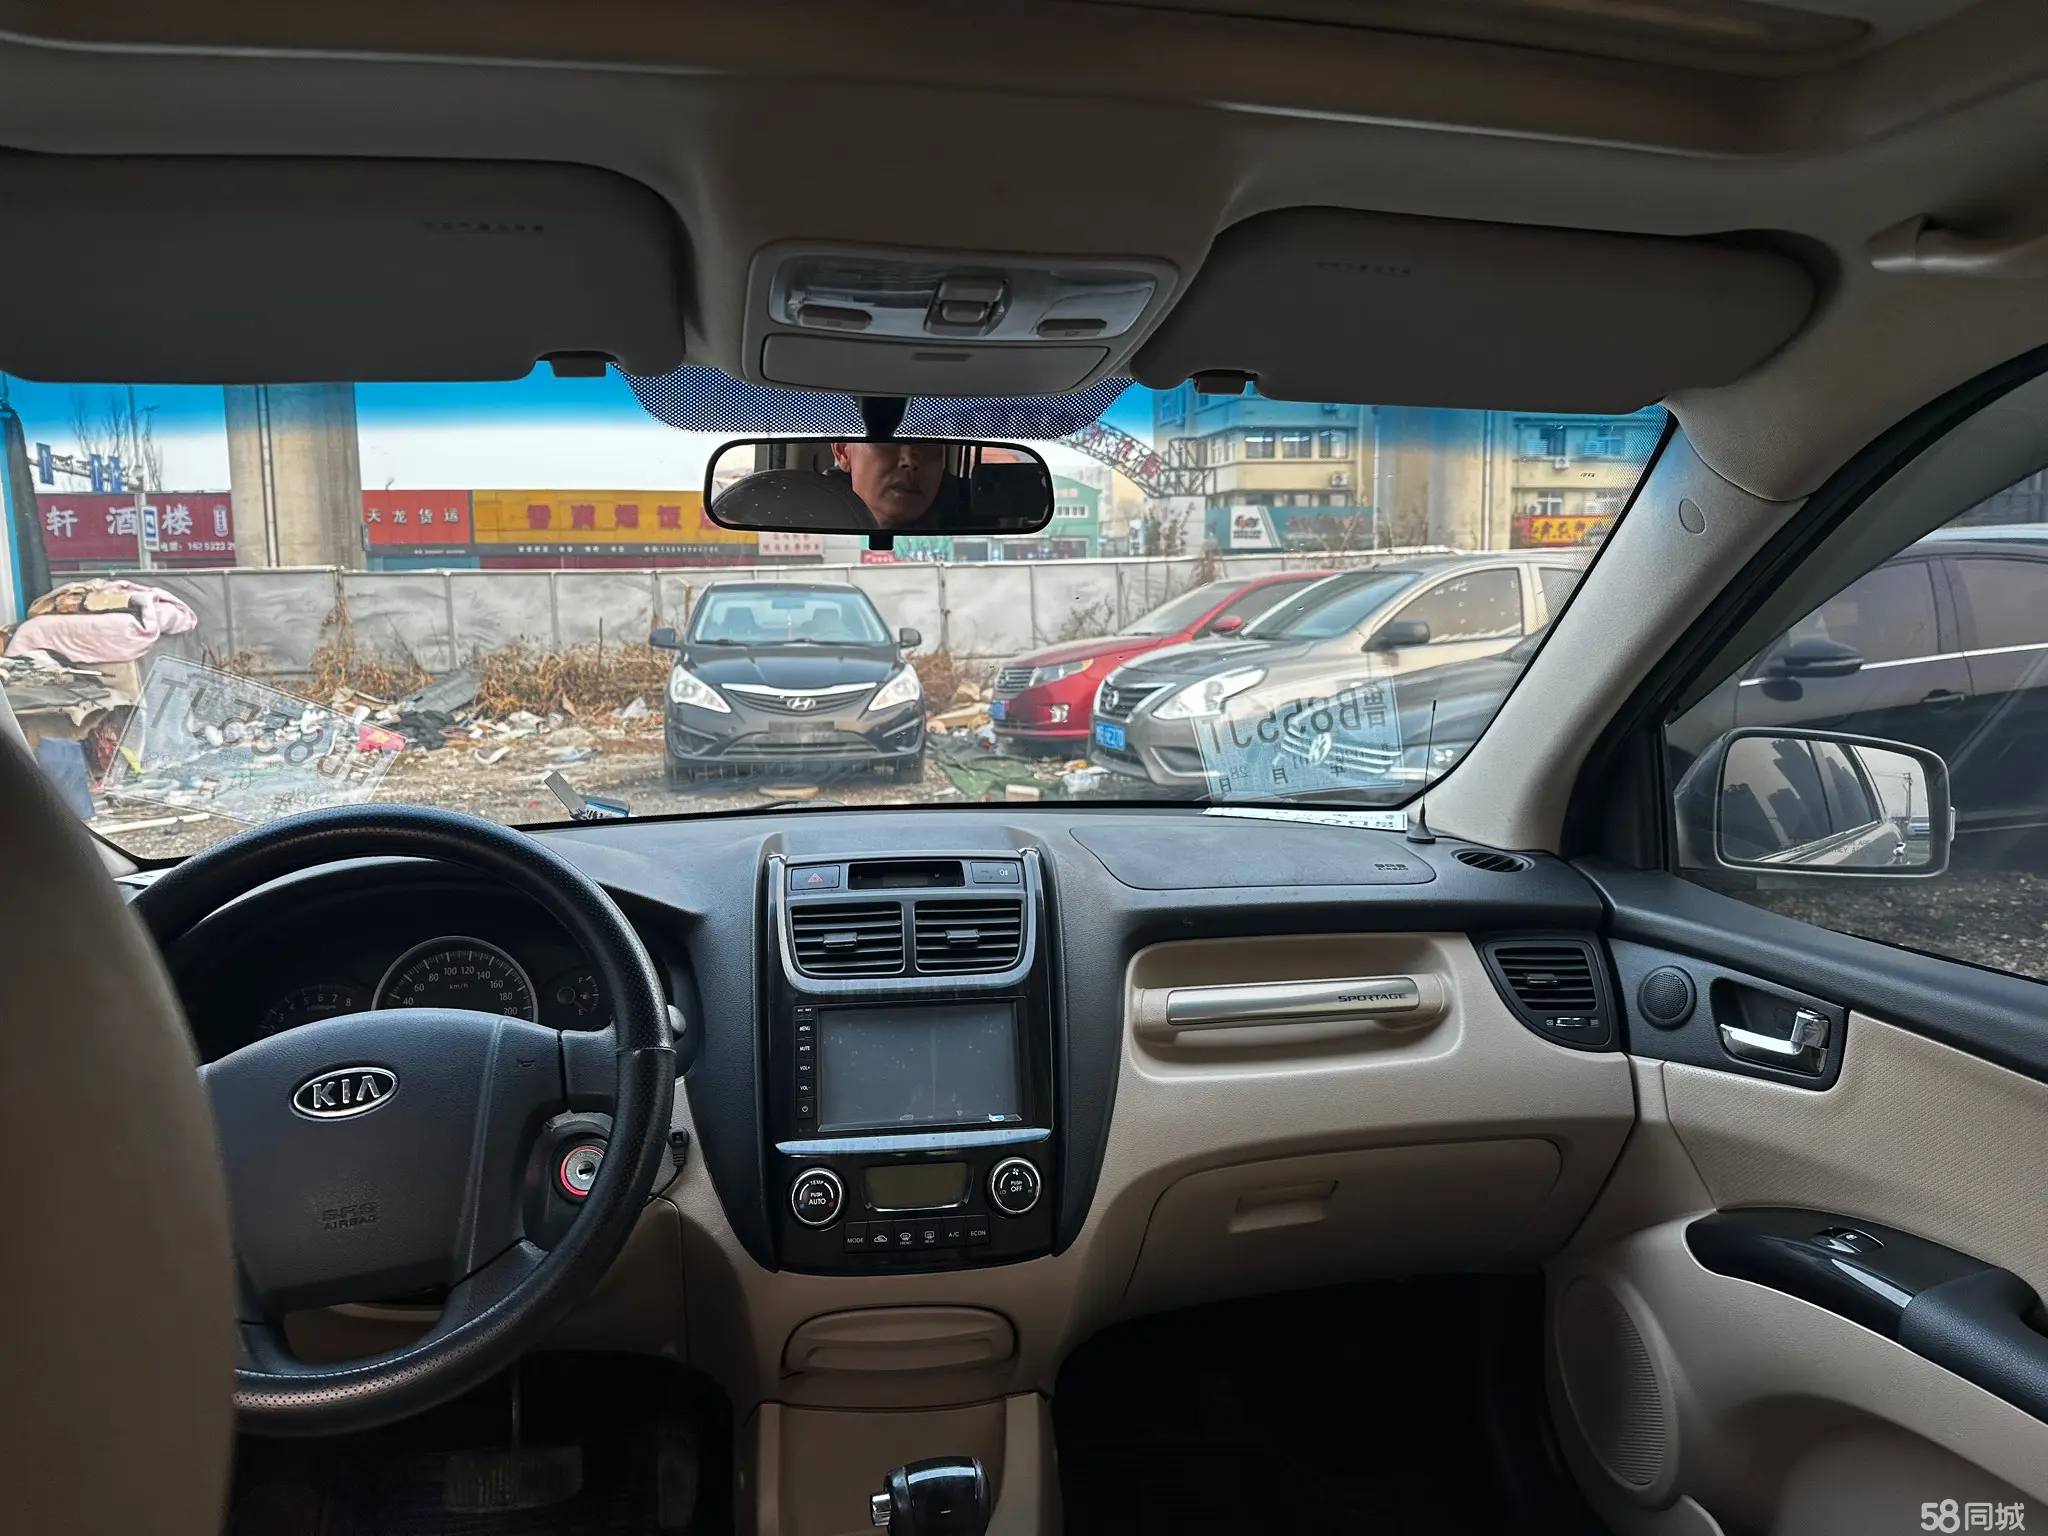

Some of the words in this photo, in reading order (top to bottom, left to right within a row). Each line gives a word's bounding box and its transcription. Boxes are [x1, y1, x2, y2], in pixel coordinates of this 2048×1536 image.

[367, 508, 461, 524] 天龙货运
[444, 967, 457, 975] 100
[461, 966, 475, 975] 120
[428, 973, 439, 982] 80
[477, 971, 491, 980] 140
[414, 983, 425, 992] 60
[490, 980, 504, 989] 160
[500, 992, 513, 1001] 180
[1338, 993, 1408, 1002] SPORTAGE
[345, 997, 352, 1007] 8
[403, 997, 414, 1006] 40
[503, 1007, 518, 1016] 200
[313, 1075, 381, 1108] KIA
[1010, 1185, 1023, 1193] OFF
[808, 1198, 827, 1206] AUTO
